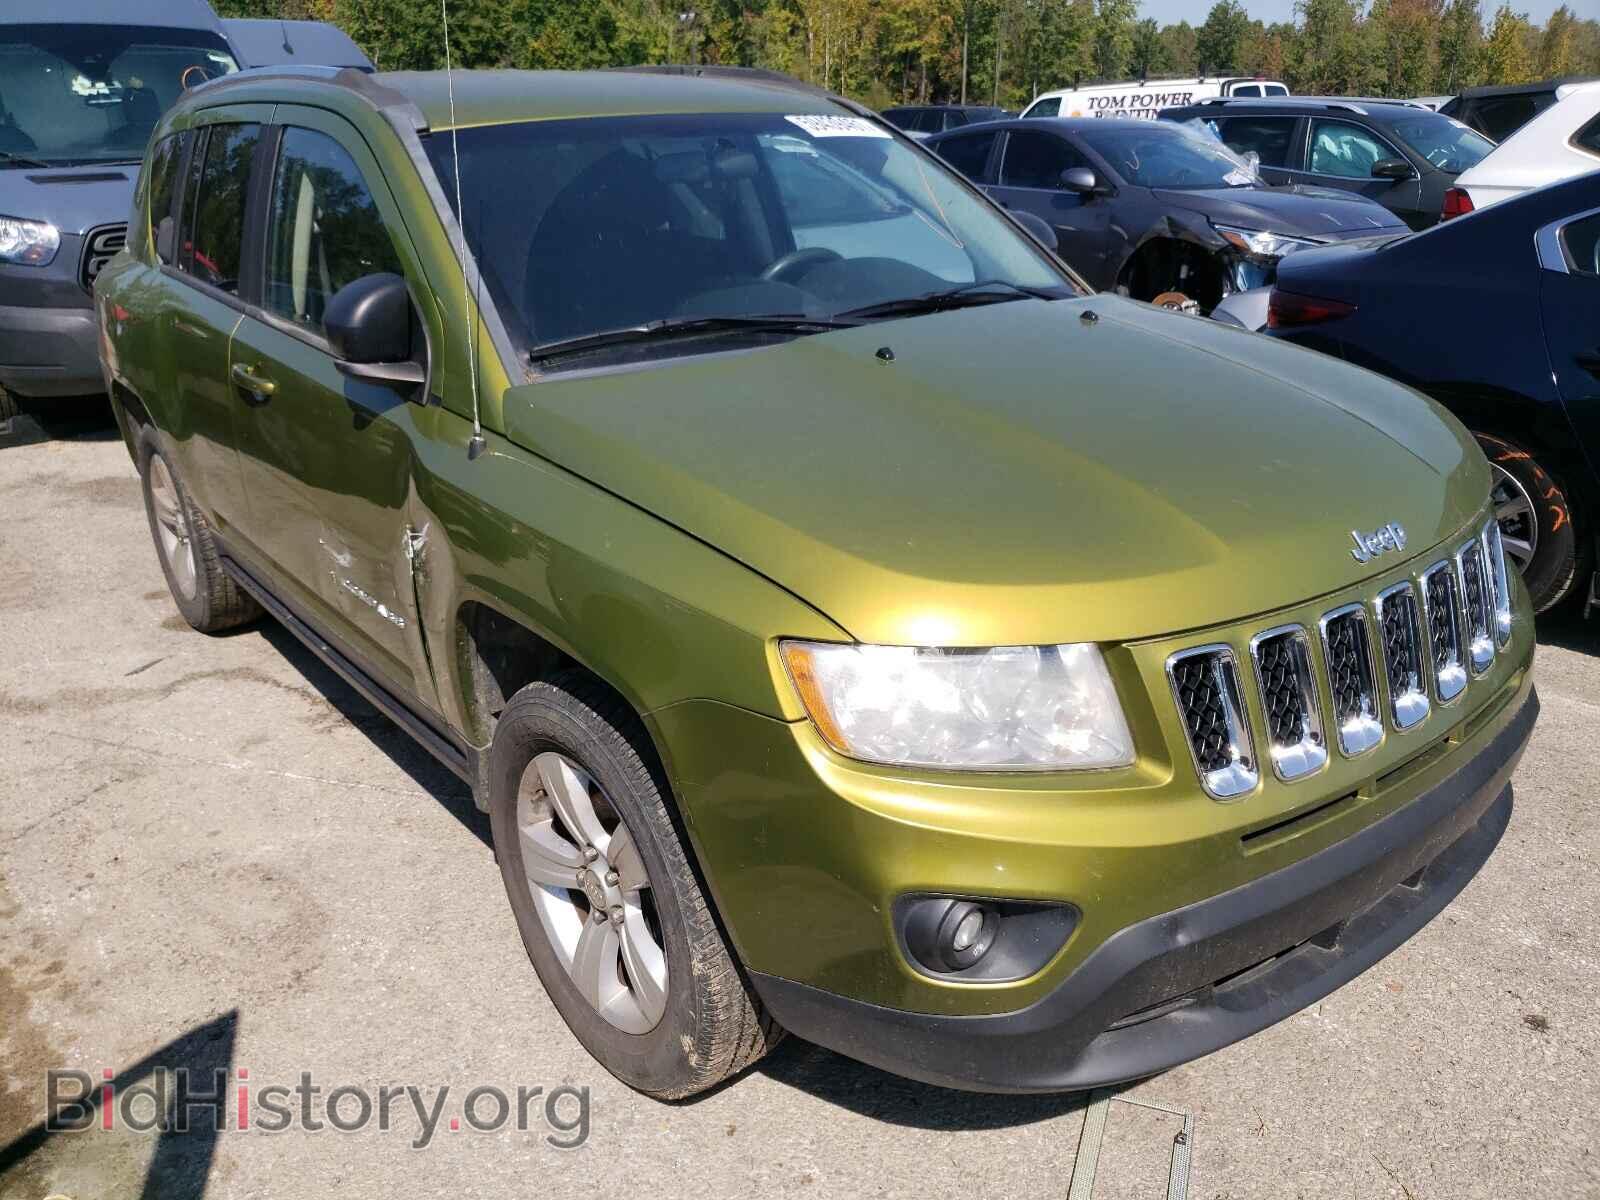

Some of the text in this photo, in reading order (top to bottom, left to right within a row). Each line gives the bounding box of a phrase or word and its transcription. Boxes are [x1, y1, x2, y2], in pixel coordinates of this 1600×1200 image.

[1088, 92, 1193, 110] TOM POWER
[1350, 522, 1407, 563] Jeep
